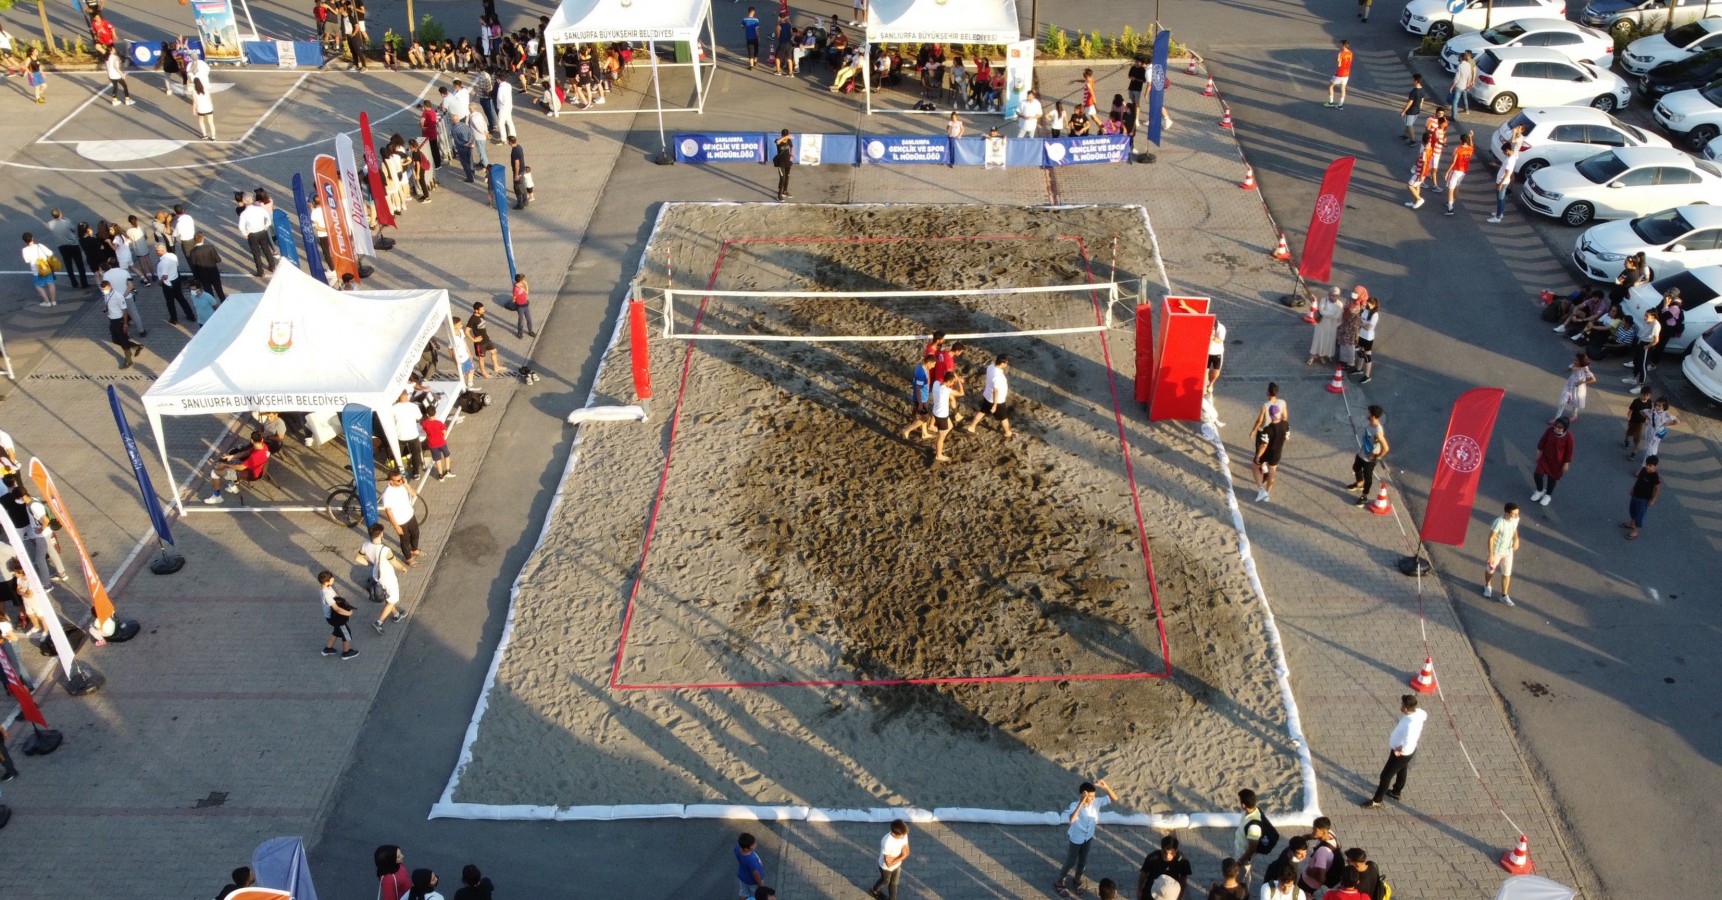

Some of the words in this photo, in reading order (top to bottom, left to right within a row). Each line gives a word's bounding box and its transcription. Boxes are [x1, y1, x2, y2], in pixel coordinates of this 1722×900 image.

[325, 184, 347, 254] TEKNOSA
[347, 170, 367, 229] Piazza
[181, 397, 232, 409] ŞANLIURFA
[296, 393, 349, 406] BELEDİYESİ
